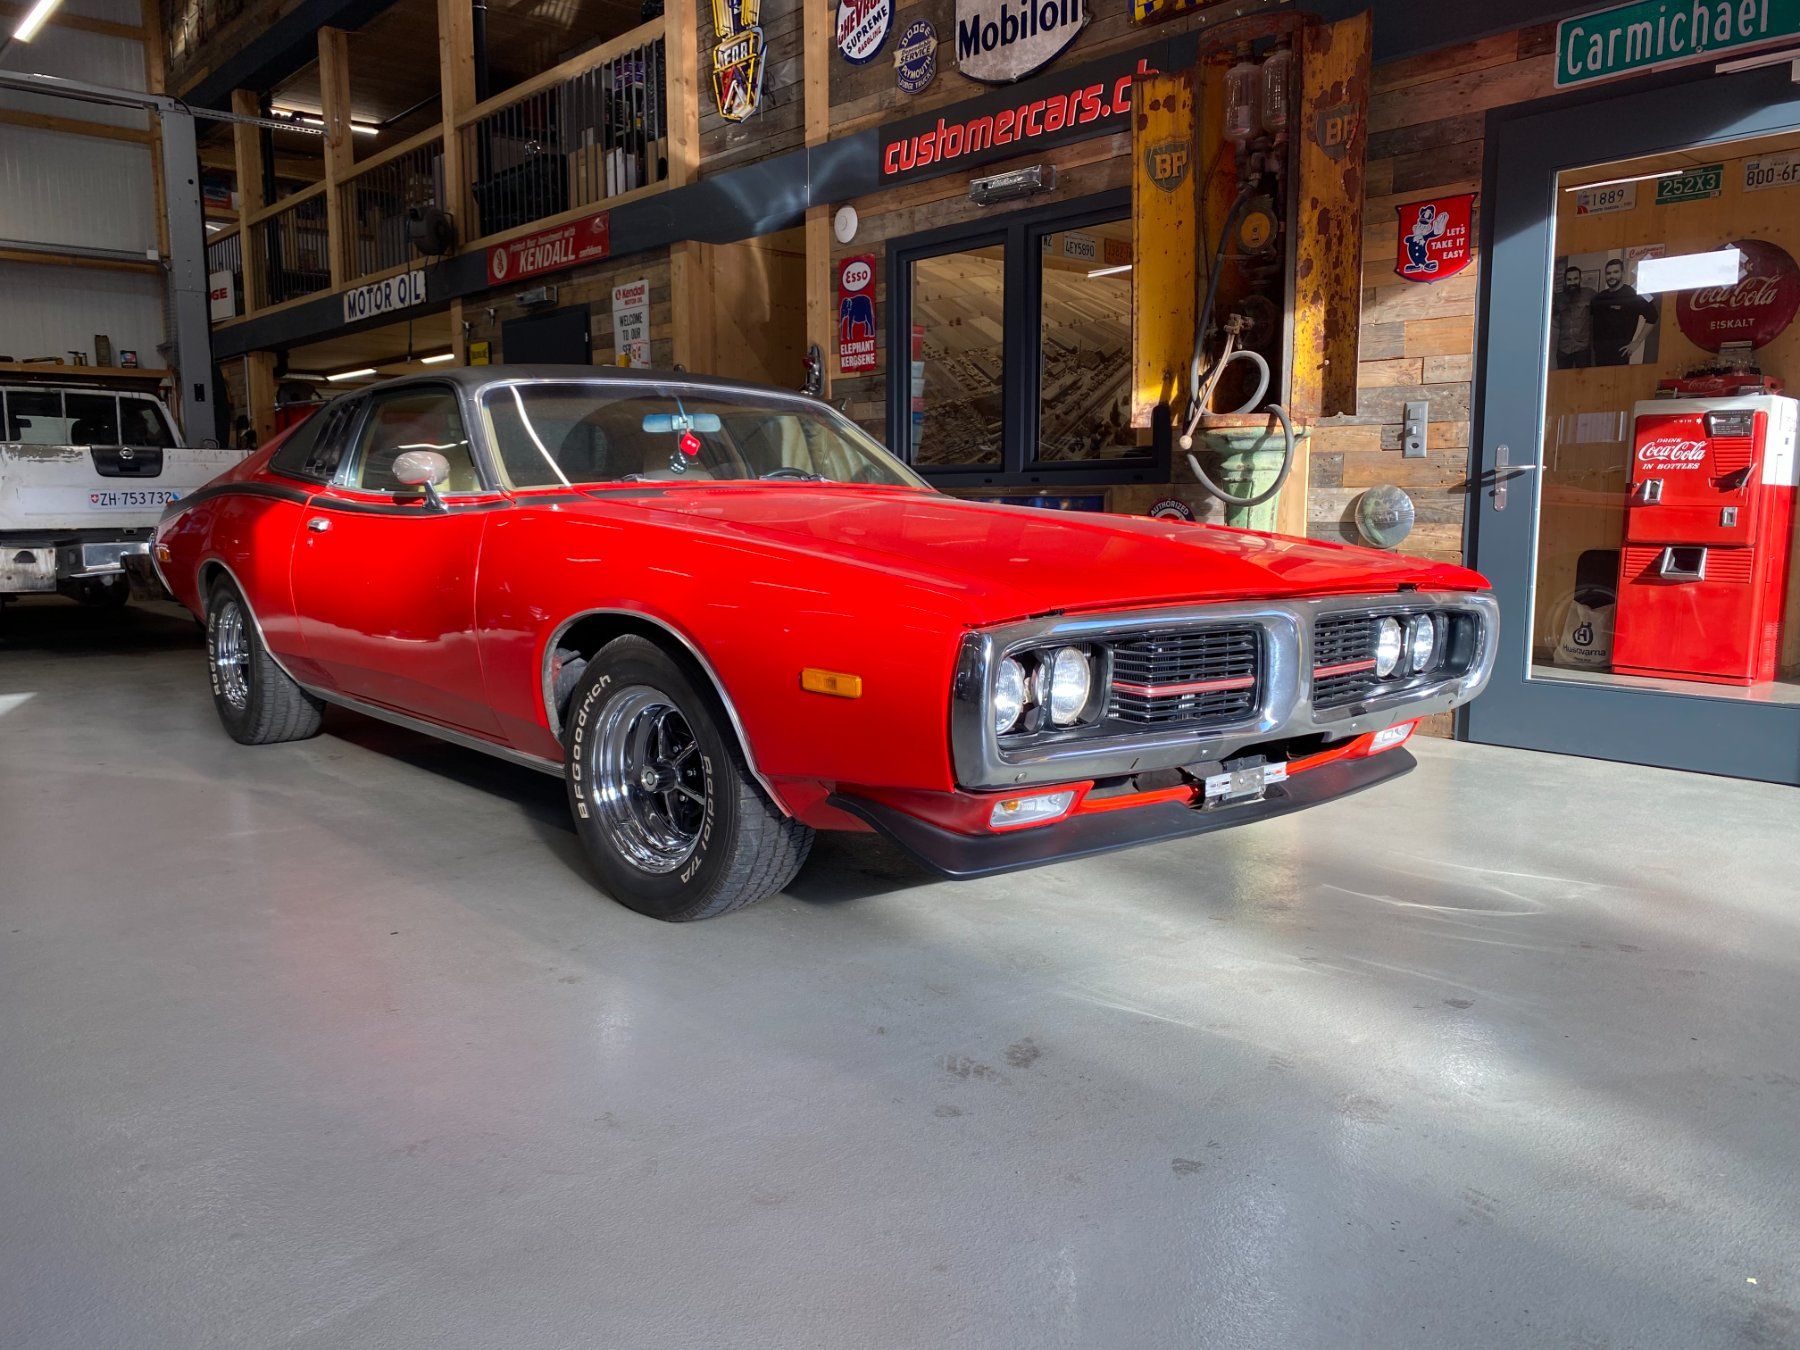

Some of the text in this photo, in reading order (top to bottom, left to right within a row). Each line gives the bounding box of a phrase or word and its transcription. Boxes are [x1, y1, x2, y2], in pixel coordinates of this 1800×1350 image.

[838, 0, 881, 45] CHEVRO
[846, 5, 888, 53] SUPREME
[901, 22, 931, 47] DODGE
[1566, 0, 1768, 76] Carmichael
[900, 46, 931, 65] SERVICE
[902, 56, 932, 79] PLYMOUTH
[1153, 150, 1188, 180] BP
[1662, 174, 1717, 196] 252X3
[1592, 189, 1625, 206] 1889
[1447, 223, 1466, 237] LET'S
[1431, 237, 1465, 251] TAKE IT
[519, 237, 576, 273] KENDALL
[1442, 249, 1465, 260] EASY
[348, 273, 421, 319] MOTOR OL
[622, 284, 645, 299] Kendall
[618, 311, 643, 328] WELCOME
[1710, 317, 1755, 331] EISKALT
[622, 327, 641, 341] TO OUR
[840, 340, 875, 355] ELEPHANT
[841, 353, 876, 368] KEROSENE
[1642, 462, 1701, 471] IN BOTTLES
[1150, 500, 1189, 517] AUTHORIZED
[1562, 643, 1607, 657] Husqvarna
[571, 673, 612, 820] BFGoodrich
[680, 855, 702, 884] T/A
